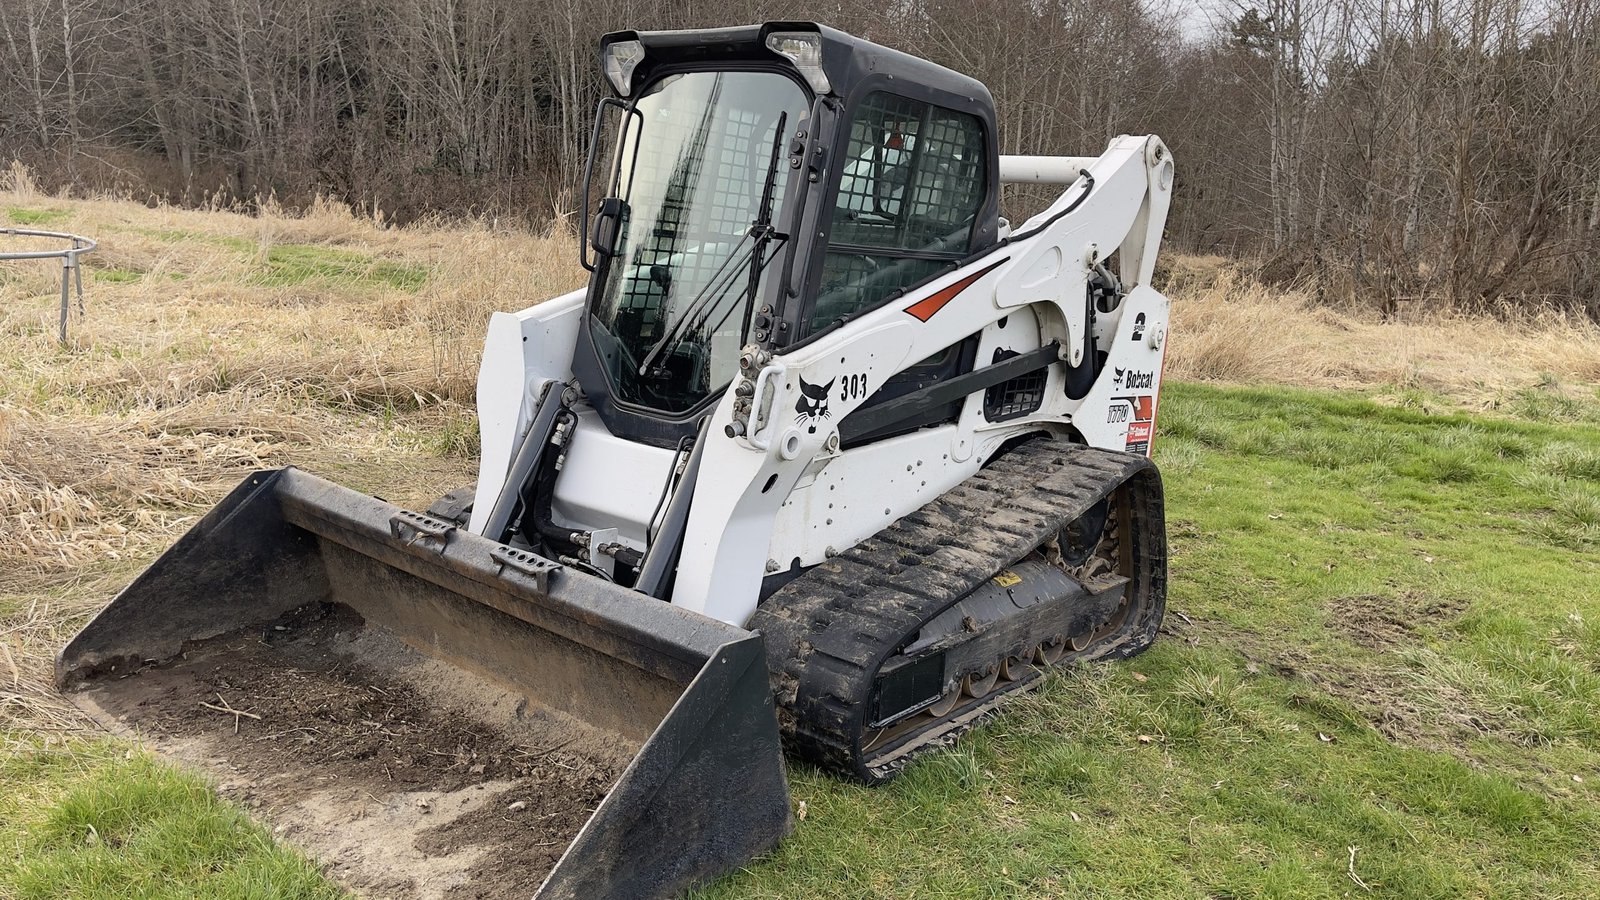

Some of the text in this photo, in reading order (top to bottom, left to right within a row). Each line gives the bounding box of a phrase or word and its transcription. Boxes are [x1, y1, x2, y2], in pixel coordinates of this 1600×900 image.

[1131, 312, 1146, 341] 2
[841, 373, 867, 402] 303
[1125, 370, 1153, 389] Bobcat
[1107, 404, 1129, 424] T770
